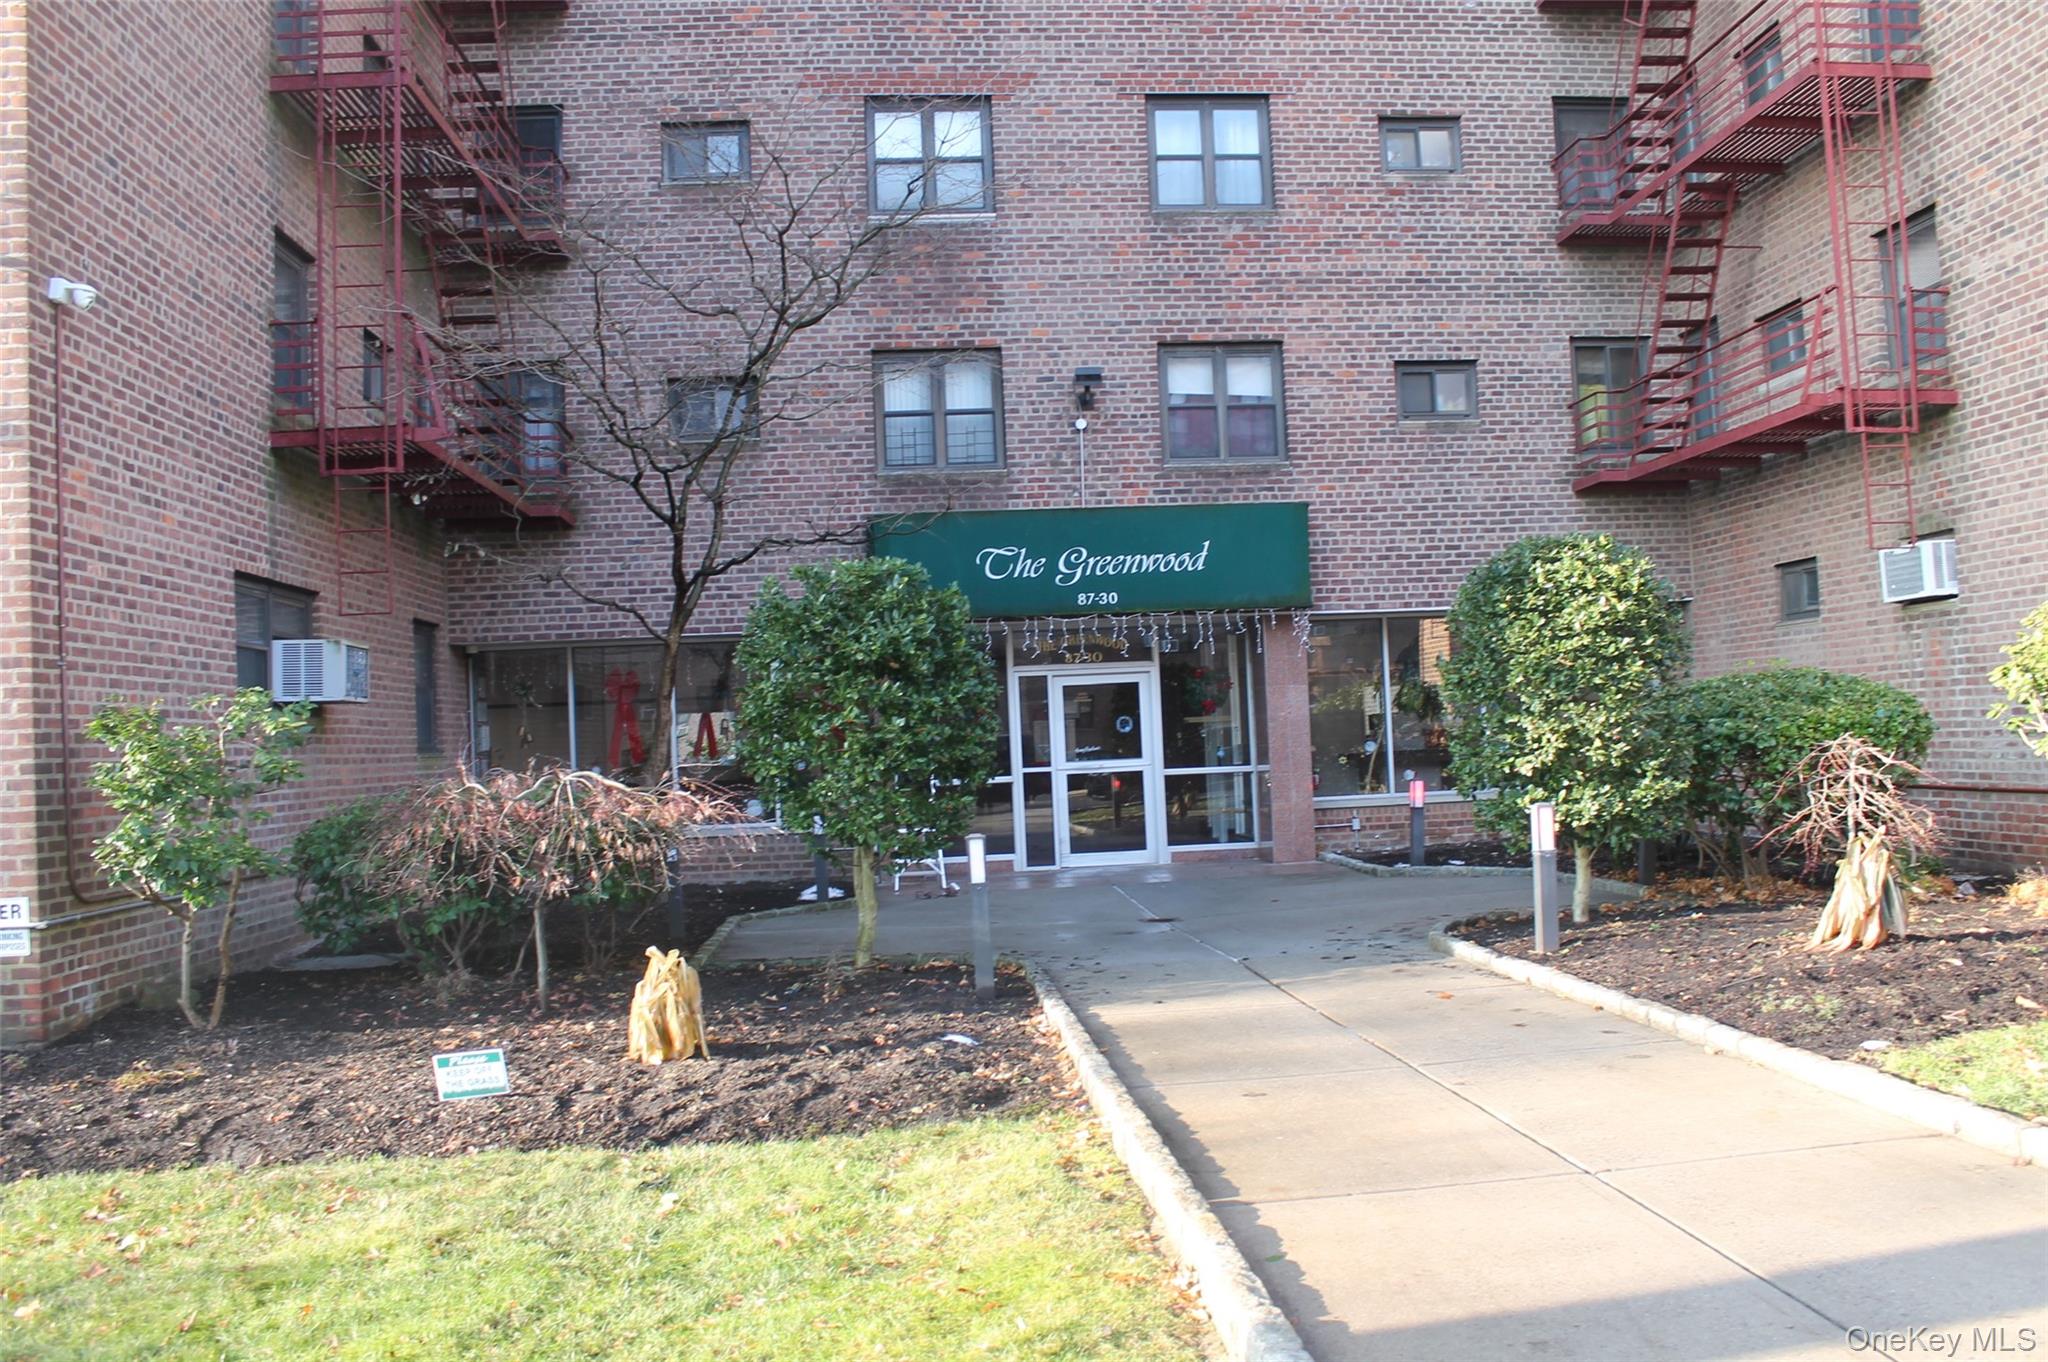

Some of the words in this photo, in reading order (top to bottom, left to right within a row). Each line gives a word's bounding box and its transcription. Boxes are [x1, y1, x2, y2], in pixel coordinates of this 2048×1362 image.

[976, 546, 1046, 580] The
[1055, 540, 1210, 586] Greenwood
[1077, 592, 1118, 606] 87-30
[446, 1067, 471, 1078] KEEP
[445, 1079, 463, 1088] THE
[467, 1075, 500, 1086] GRASS
